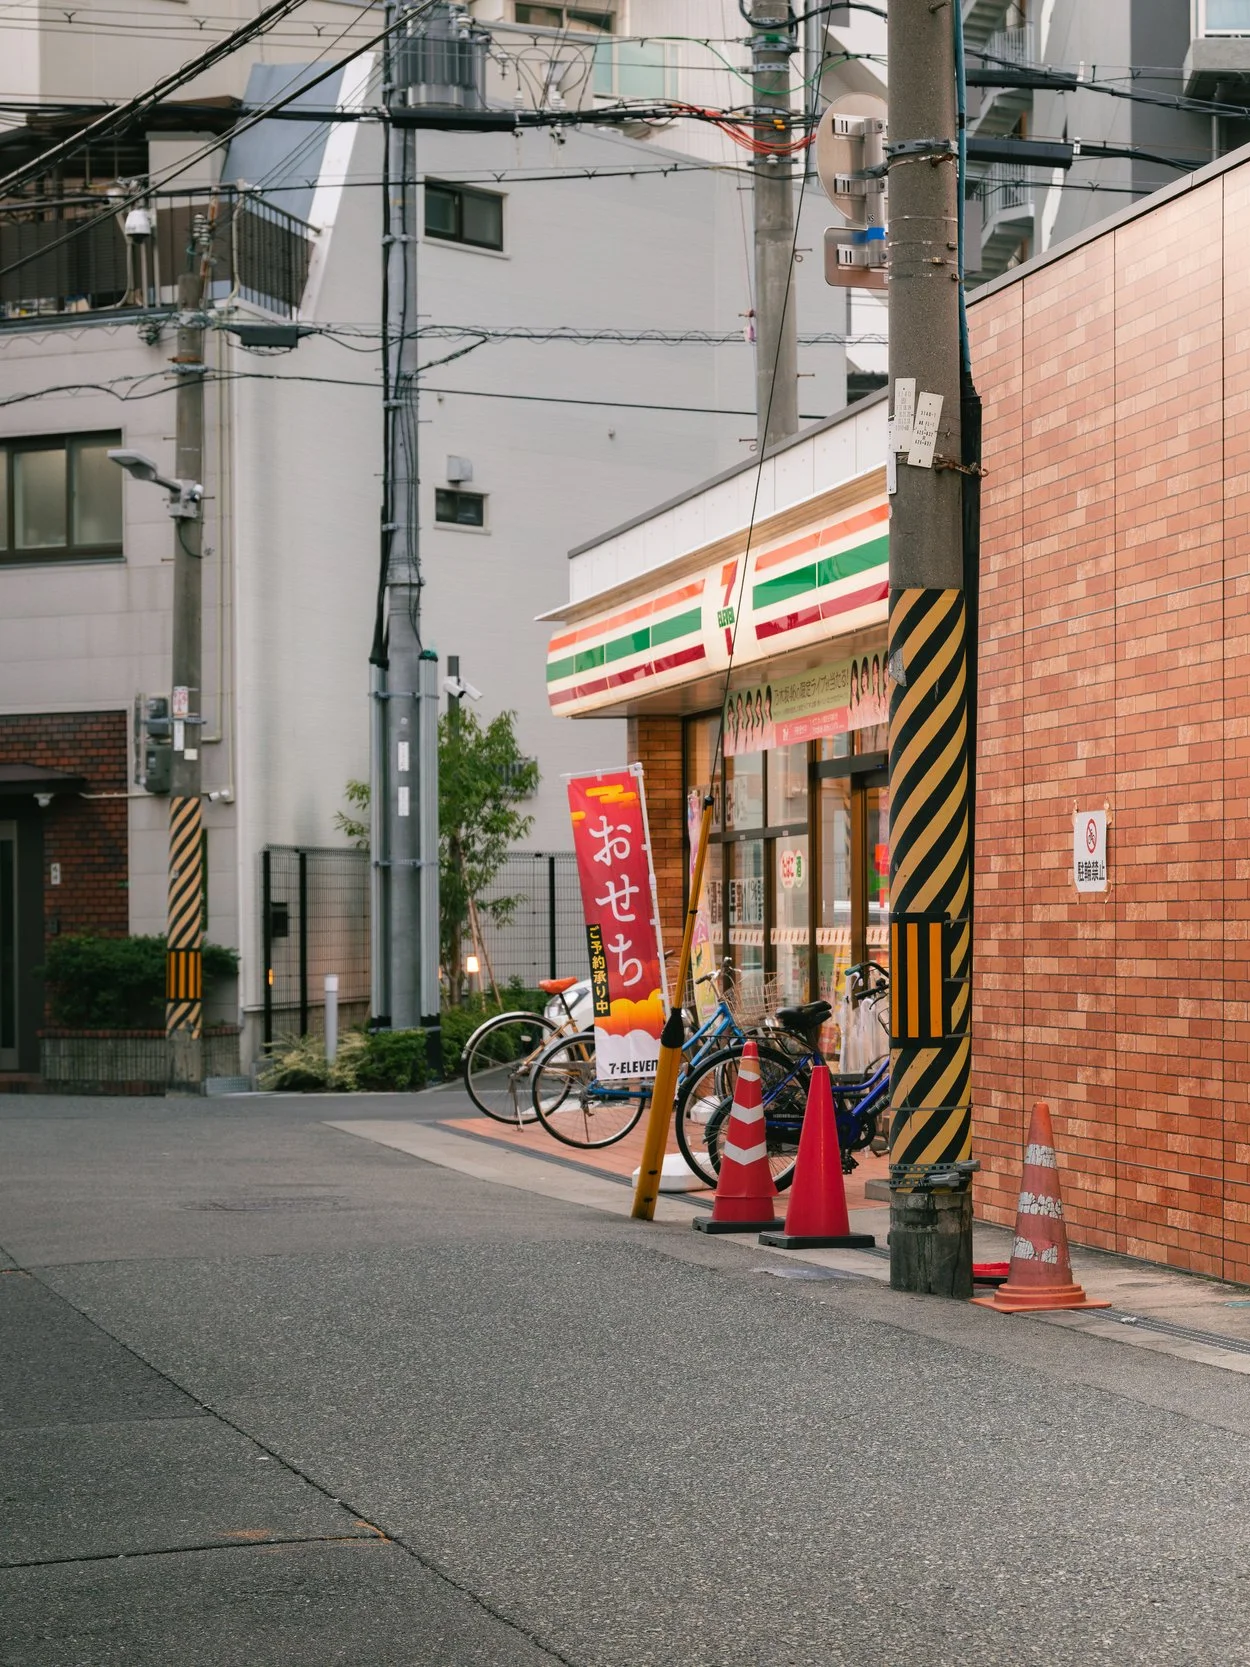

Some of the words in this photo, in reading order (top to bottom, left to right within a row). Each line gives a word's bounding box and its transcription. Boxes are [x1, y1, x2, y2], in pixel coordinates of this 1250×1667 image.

[588, 815, 643, 987] おせち
[1078, 860, 1105, 881] 駐輪禁止
[589, 925, 609, 1014] ご予約承り中
